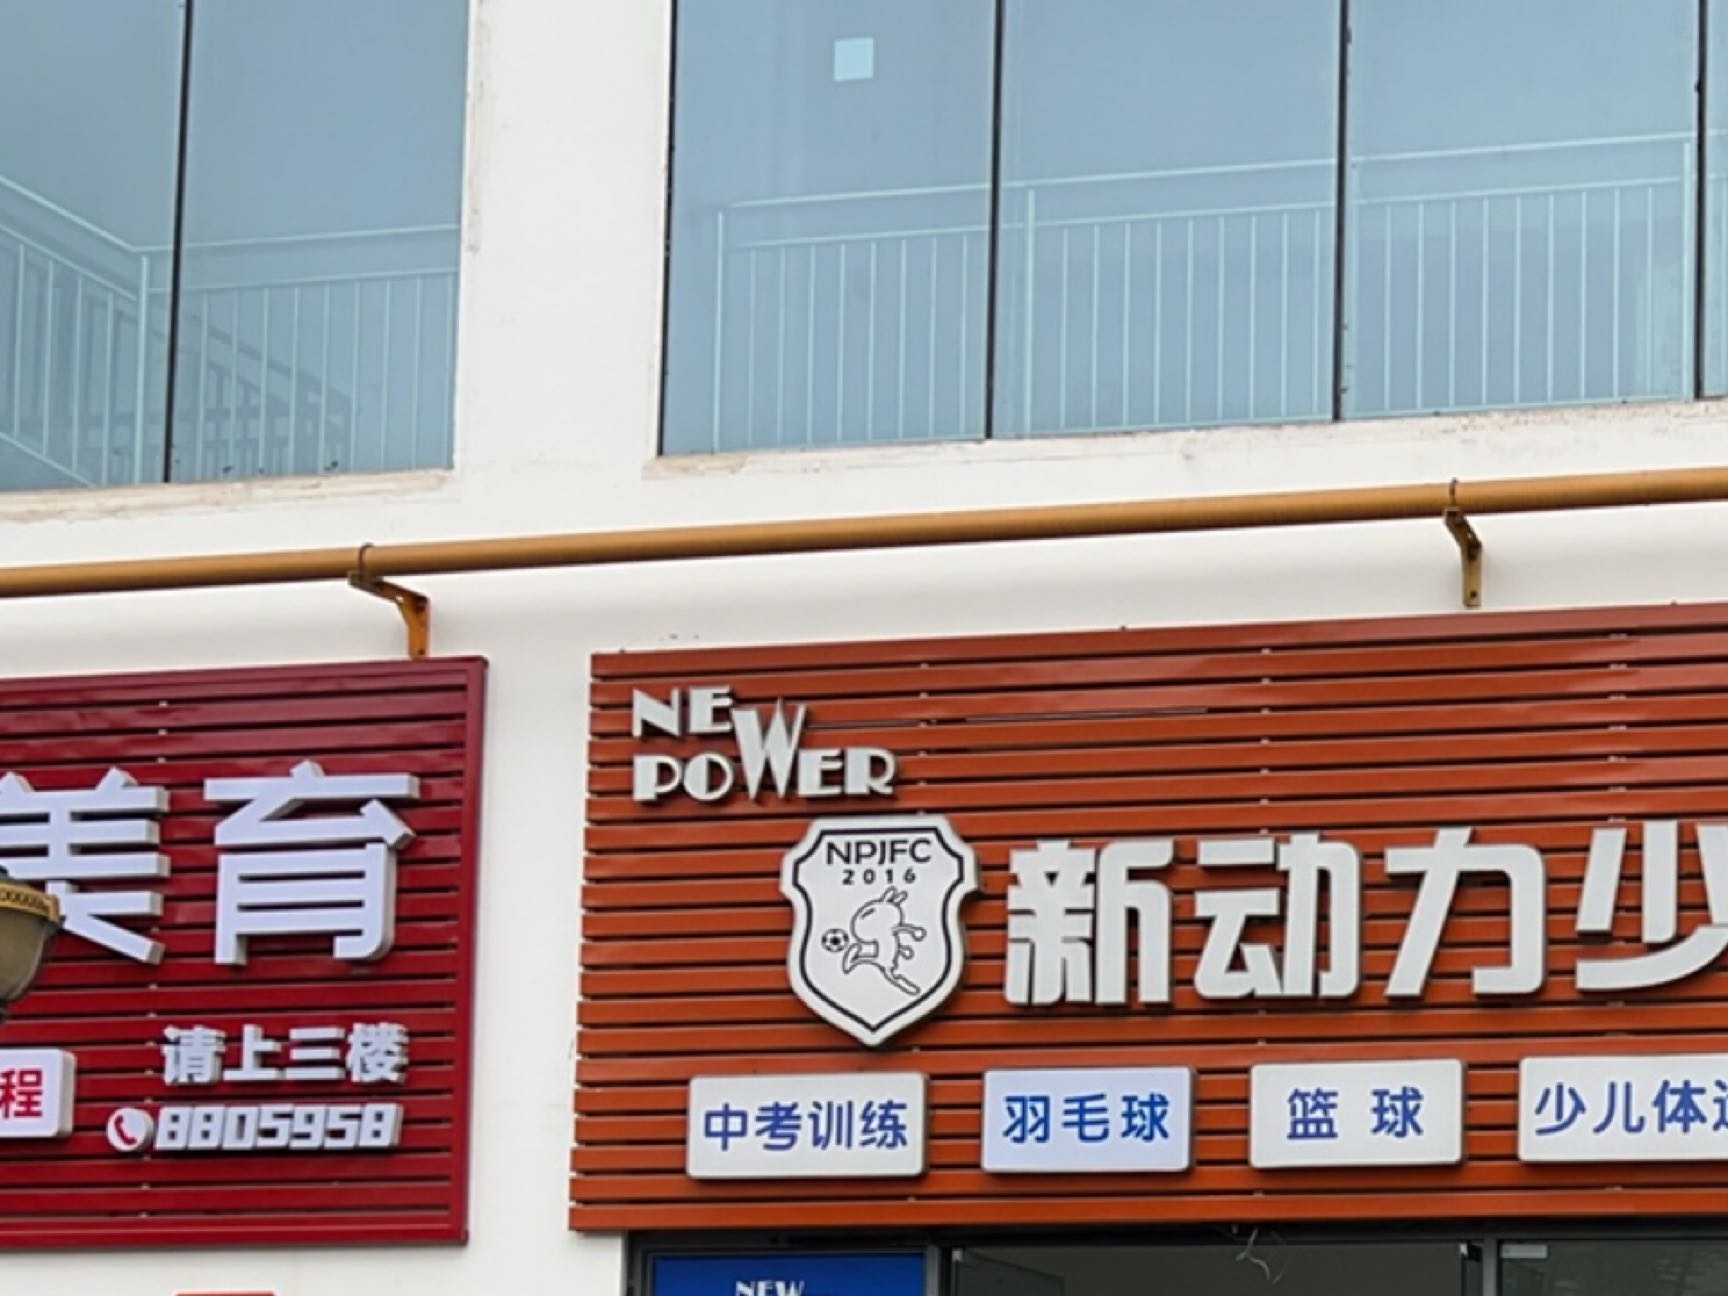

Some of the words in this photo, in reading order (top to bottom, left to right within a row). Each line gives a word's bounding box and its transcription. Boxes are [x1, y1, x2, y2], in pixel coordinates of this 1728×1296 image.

[632, 697, 897, 801] POWER
[0, 758, 420, 966] 美育
[825, 837, 933, 867] NPJFC
[842, 868, 917, 886] 2016
[162, 1021, 409, 1086] 请上三楼
[154, 1103, 403, 1151] 8805958
[703, 1100, 910, 1153] 中考训练
[1001, 1092, 1171, 1143] 羽毛球
[1286, 1086, 1425, 1140] 篮球
